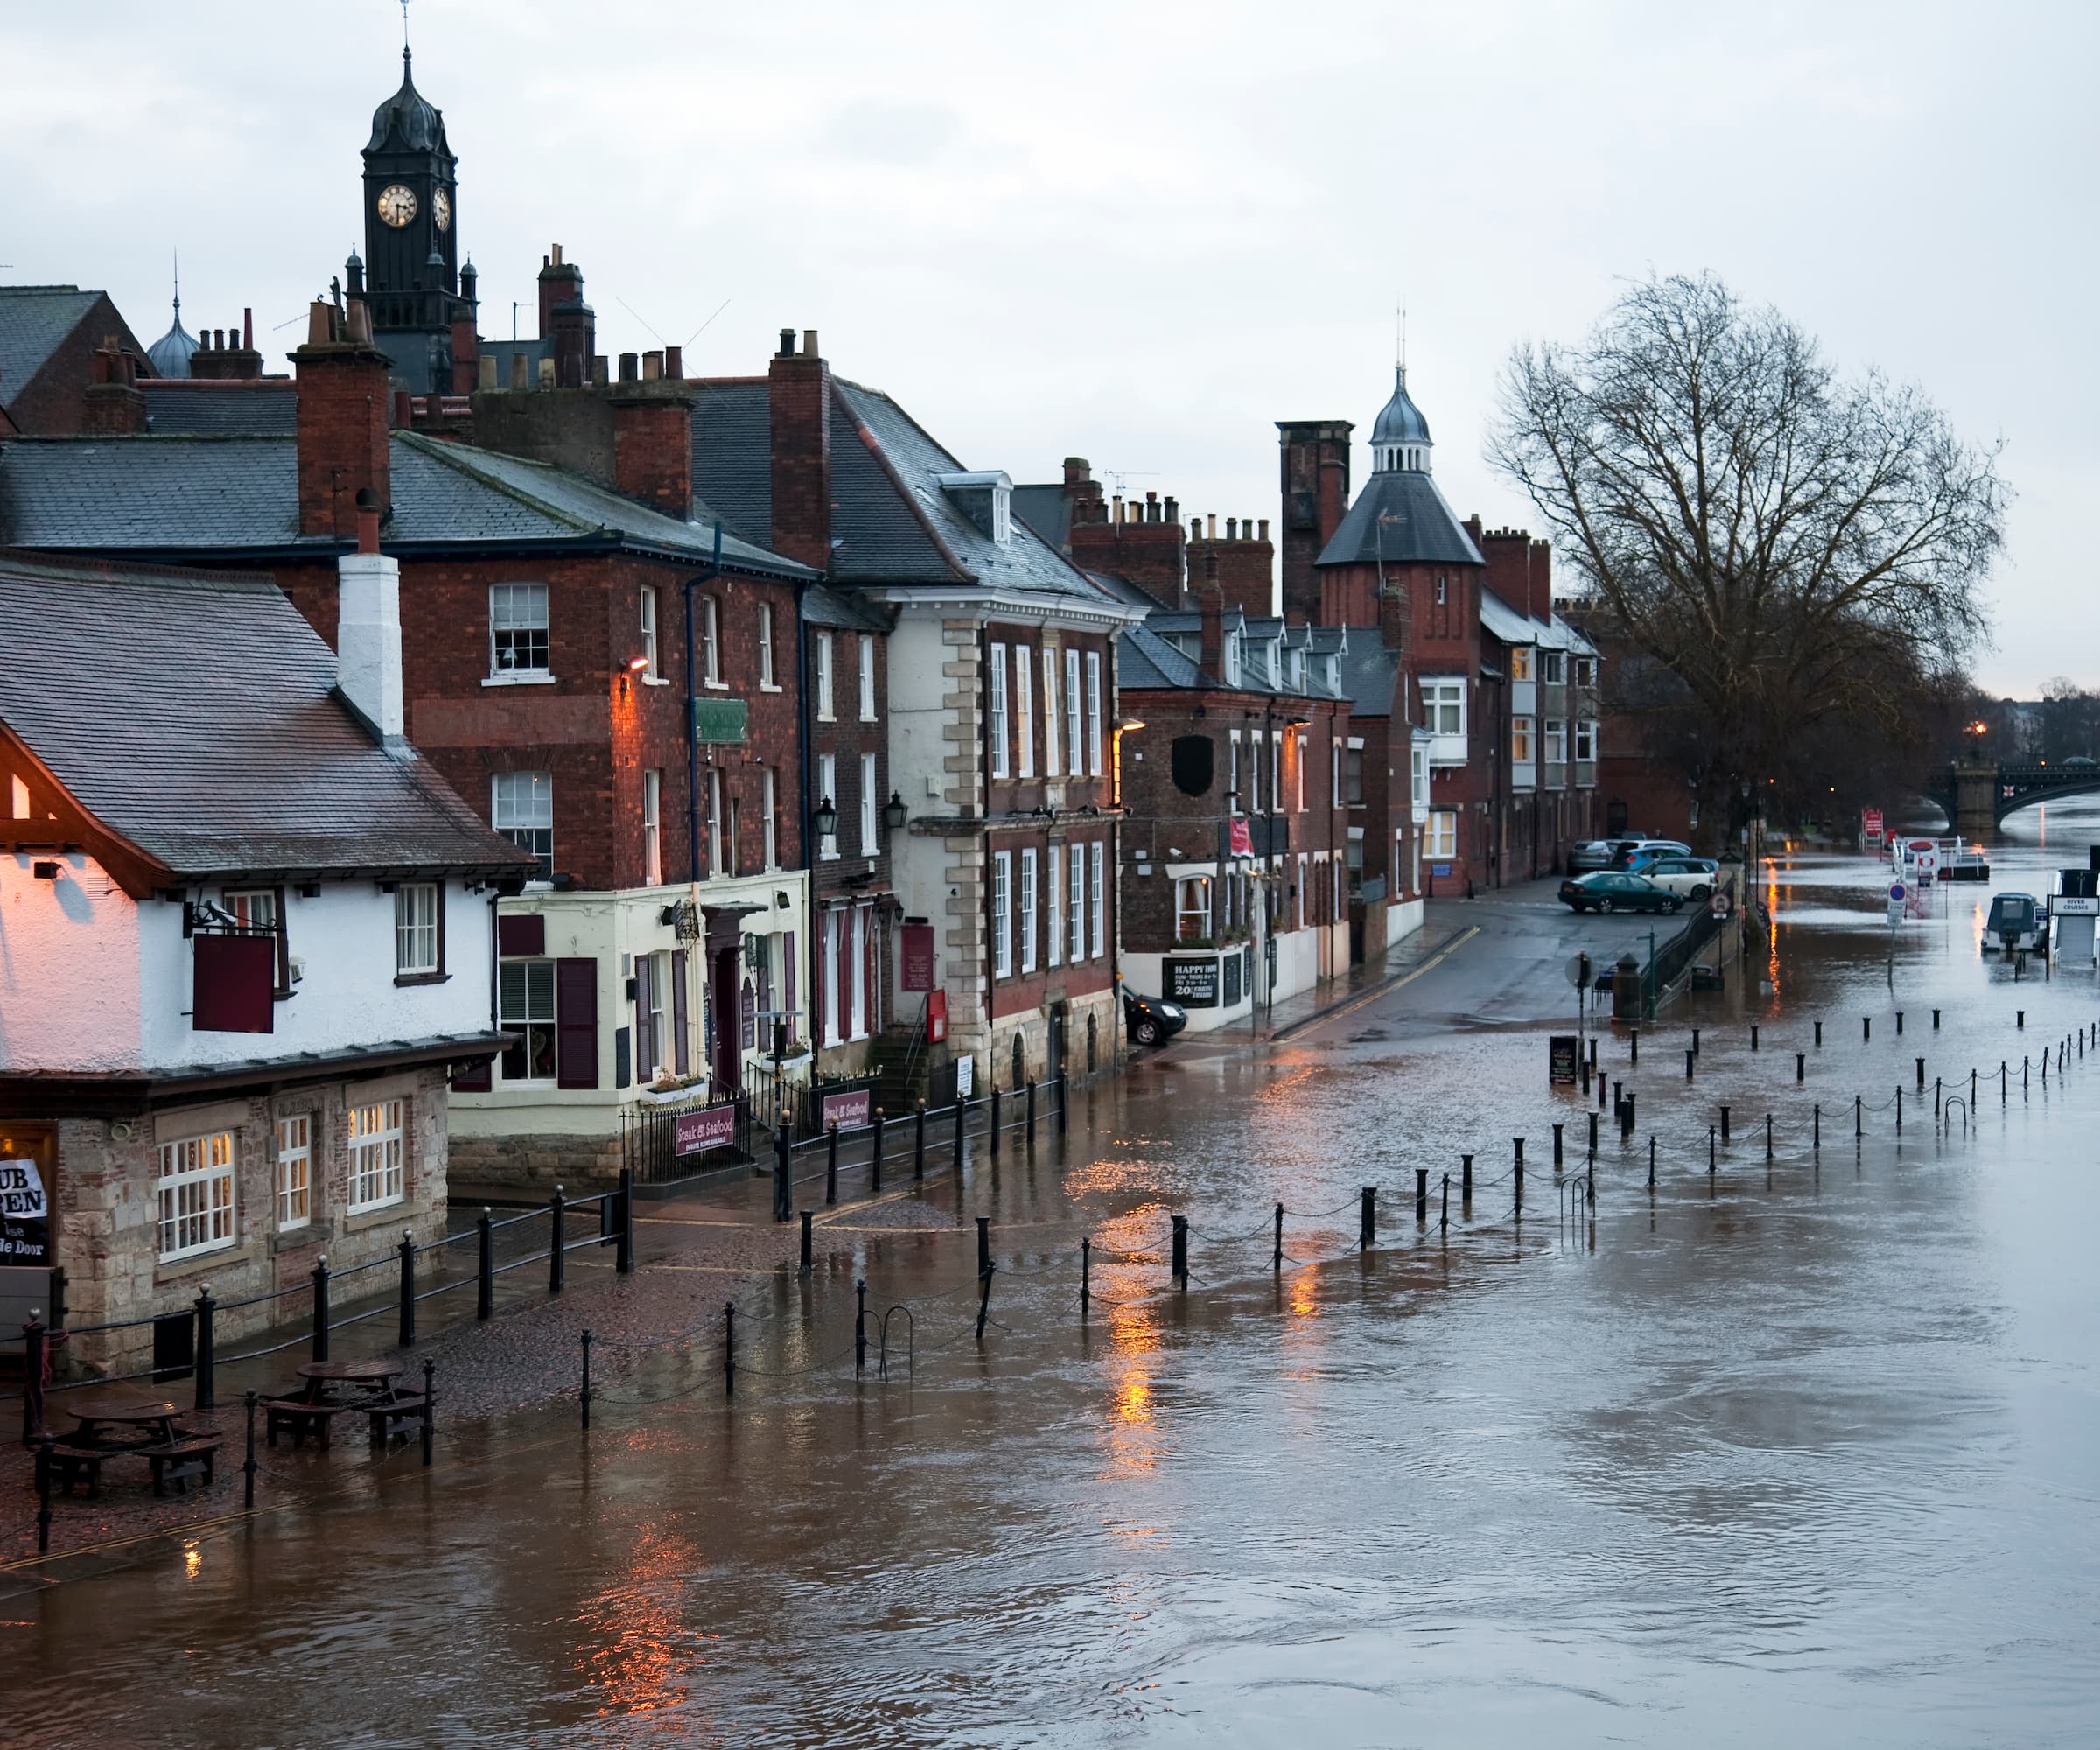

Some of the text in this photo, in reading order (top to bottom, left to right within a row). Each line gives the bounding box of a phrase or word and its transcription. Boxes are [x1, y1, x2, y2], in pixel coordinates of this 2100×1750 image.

[1175, 965, 1204, 974] HAPPY
[845, 1101, 867, 1117] Seafood
[678, 1124, 696, 1143] Steak
[705, 1116, 732, 1136] Seafood
[0, 1190, 42, 1213] EN
[15, 1240, 44, 1256] Door
